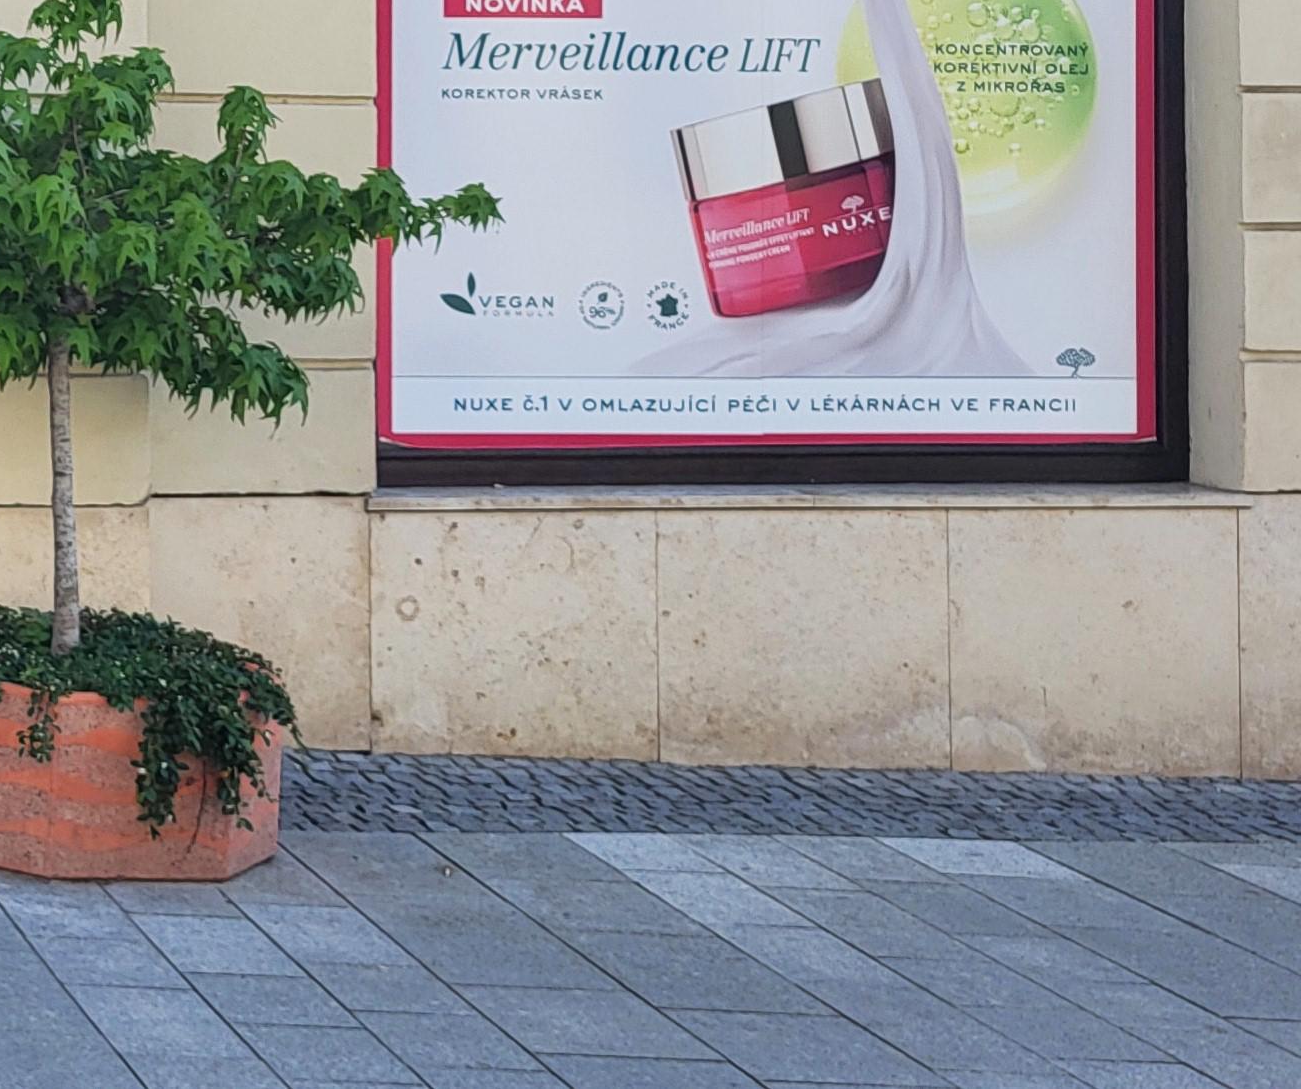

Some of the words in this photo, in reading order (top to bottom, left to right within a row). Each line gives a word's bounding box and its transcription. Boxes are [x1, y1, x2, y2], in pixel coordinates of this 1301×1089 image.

[440, 32, 730, 73] Merveillance
[737, 38, 821, 74] LIFT
[934, 42, 1089, 57] KONCENTROVANÝ
[933, 61, 1037, 75] KOREKTIVNÍ
[1044, 63, 1090, 75] OLEJ
[440, 87, 532, 101] KOREKTOR
[536, 85, 604, 101] VRÁSEK
[956, 81, 966, 92] Z
[973, 79, 1066, 93] MIKROŘAS
[821, 206, 892, 238] NUXE
[646, 280, 676, 299] MADE
[477, 295, 555, 308] VEGAN
[647, 311, 690, 330] FRANCE
[453, 397, 513, 412] NUXE
[557, 398, 573, 412] V
[581, 394, 717, 413] OMLAZUJÍCÍ
[727, 394, 777, 413] PÉČI
[786, 398, 801, 412] V
[810, 393, 941, 412] LÉKÁRNÁCH
[950, 398, 980, 412] VE
[989, 398, 1077, 412] FRANCII
